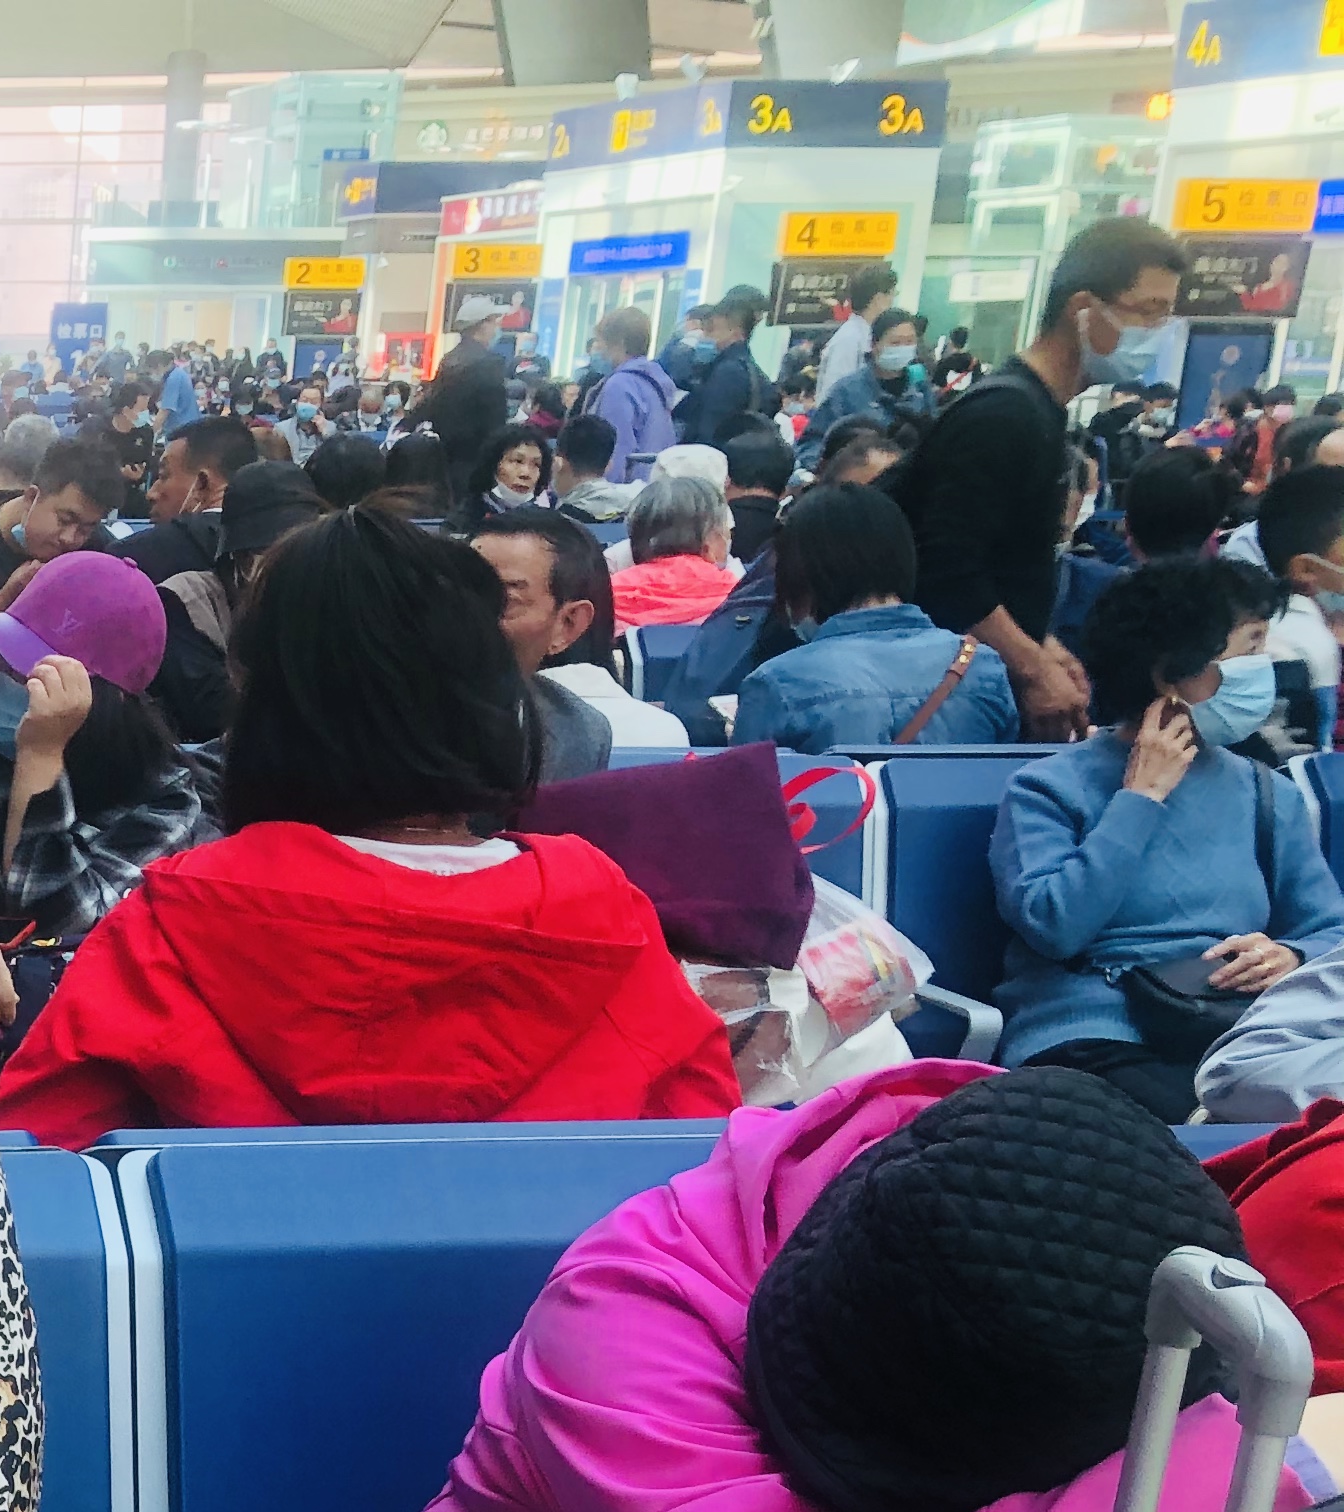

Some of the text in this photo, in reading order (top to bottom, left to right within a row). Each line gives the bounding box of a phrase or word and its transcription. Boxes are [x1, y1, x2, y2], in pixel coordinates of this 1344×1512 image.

[1187, 19, 1222, 67] 4A
[748, 93, 794, 135] 3A
[877, 93, 925, 136] 3A
[1202, 184, 1230, 223] 5
[797, 217, 820, 249] 4
[296, 262, 311, 284] 2
[463, 247, 480, 274] 3
